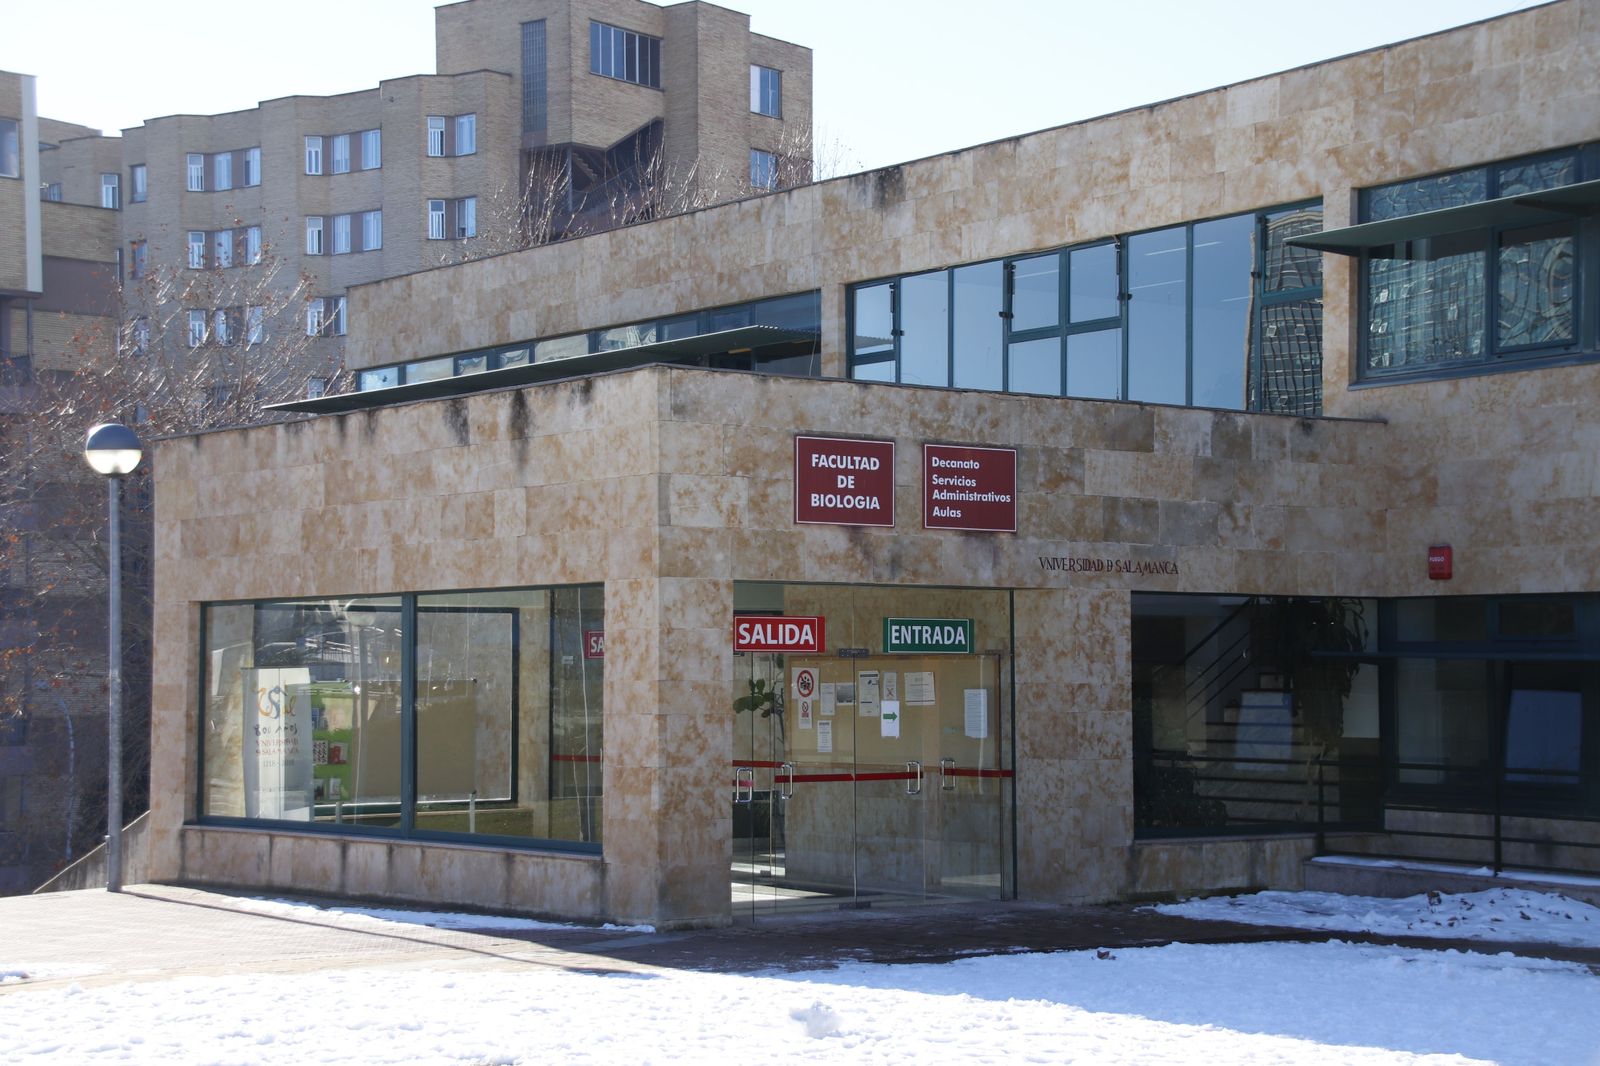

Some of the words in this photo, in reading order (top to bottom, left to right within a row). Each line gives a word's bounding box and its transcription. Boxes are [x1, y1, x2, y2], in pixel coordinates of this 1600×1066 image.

[811, 453, 880, 471] FACULTAD
[931, 456, 980, 470] Decanato
[837, 475, 855, 489] DE
[931, 474, 977, 487] Servicios
[810, 493, 881, 510] BIOLOGIA
[932, 489, 1011, 503] Administrativos
[932, 506, 962, 518] Aulas
[1115, 559, 1179, 576] SALAMANCA
[738, 623, 815, 645] SALIDA
[891, 625, 966, 645] ENTRADA
